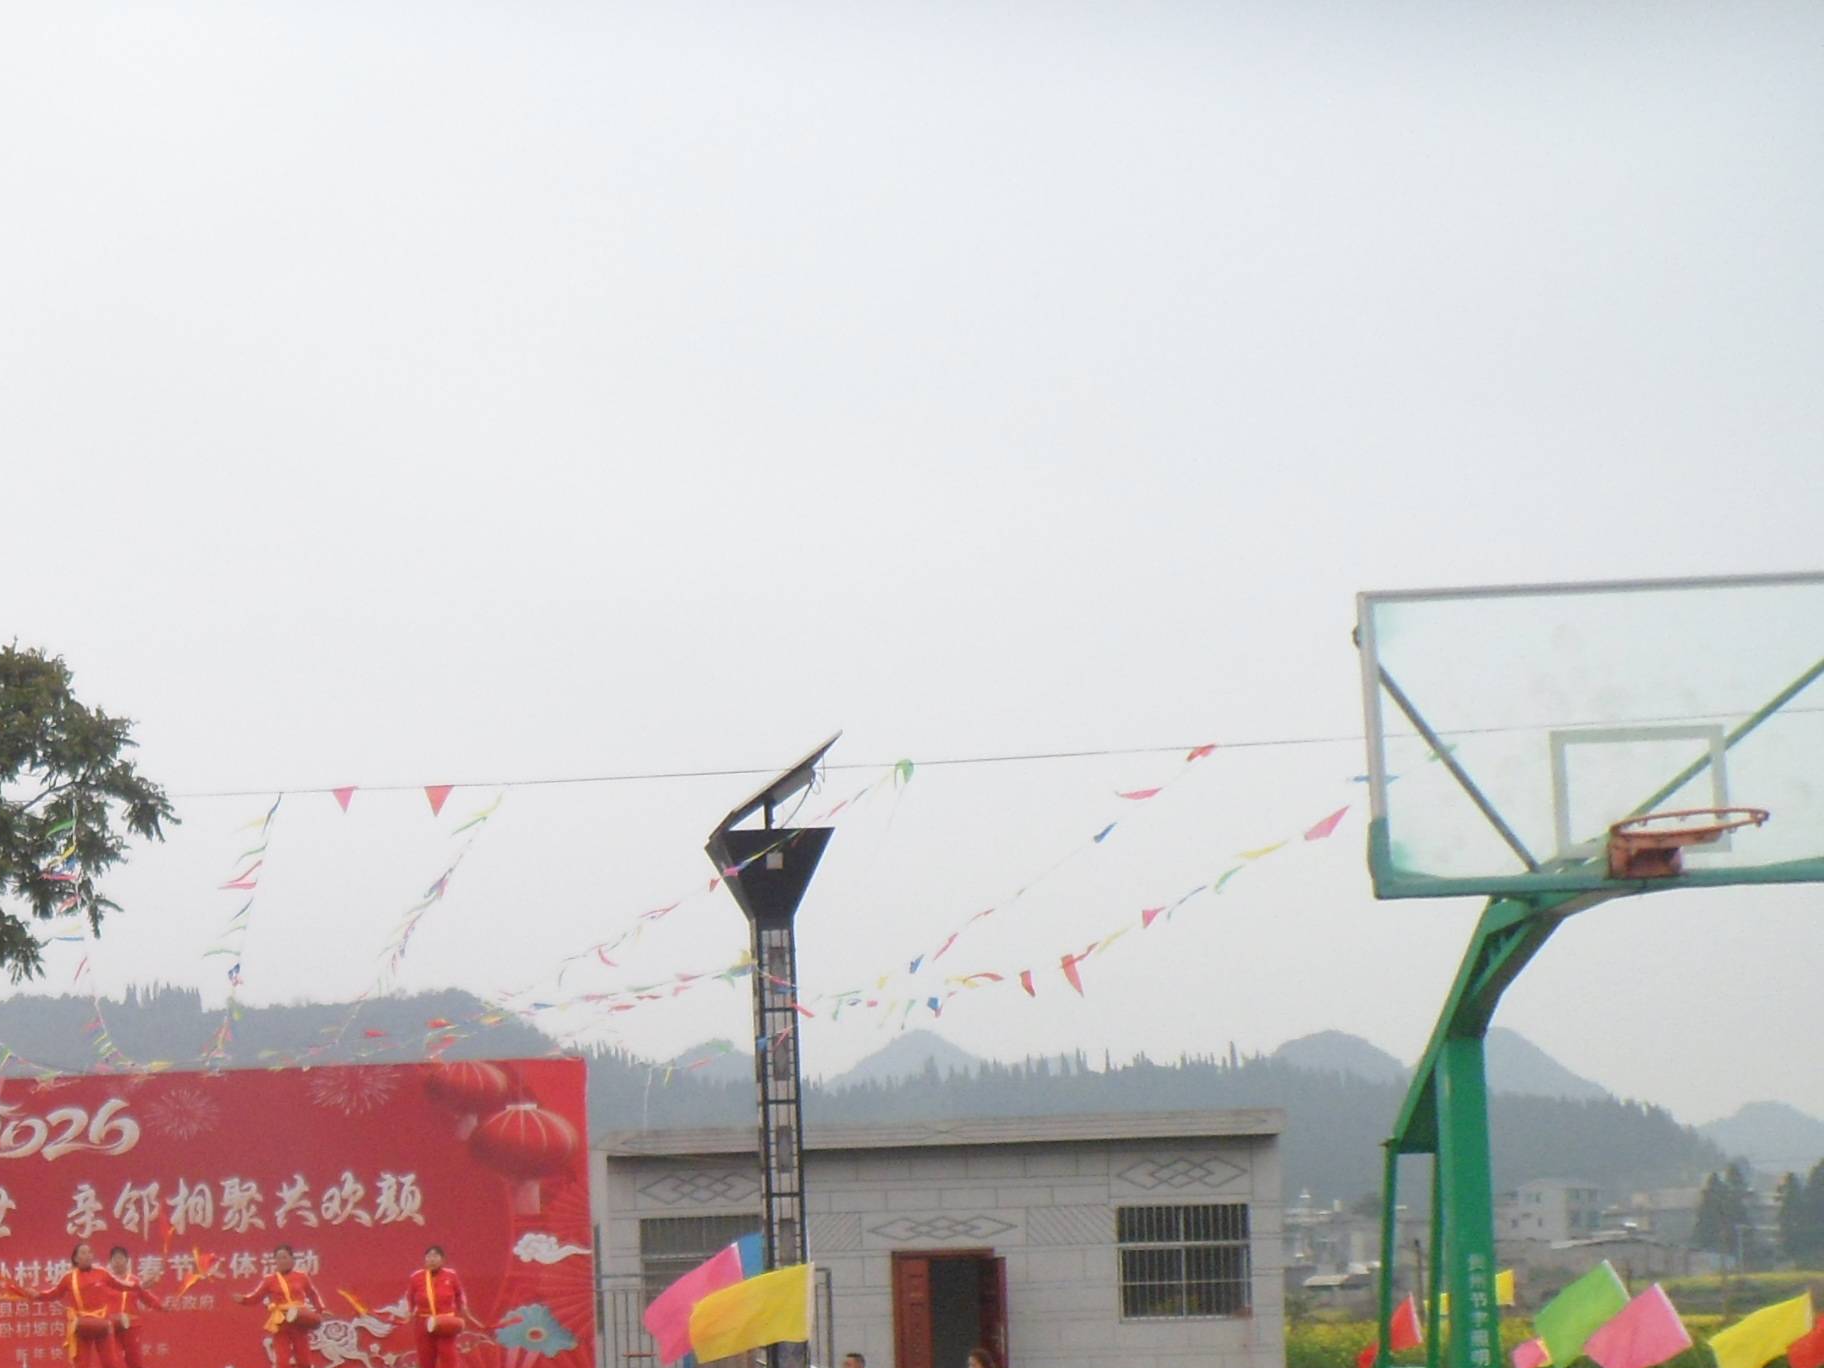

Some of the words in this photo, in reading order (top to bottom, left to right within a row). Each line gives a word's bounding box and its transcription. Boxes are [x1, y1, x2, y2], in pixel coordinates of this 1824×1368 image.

[66, 1171, 425, 1242] 亲邻相聚共欢颜
